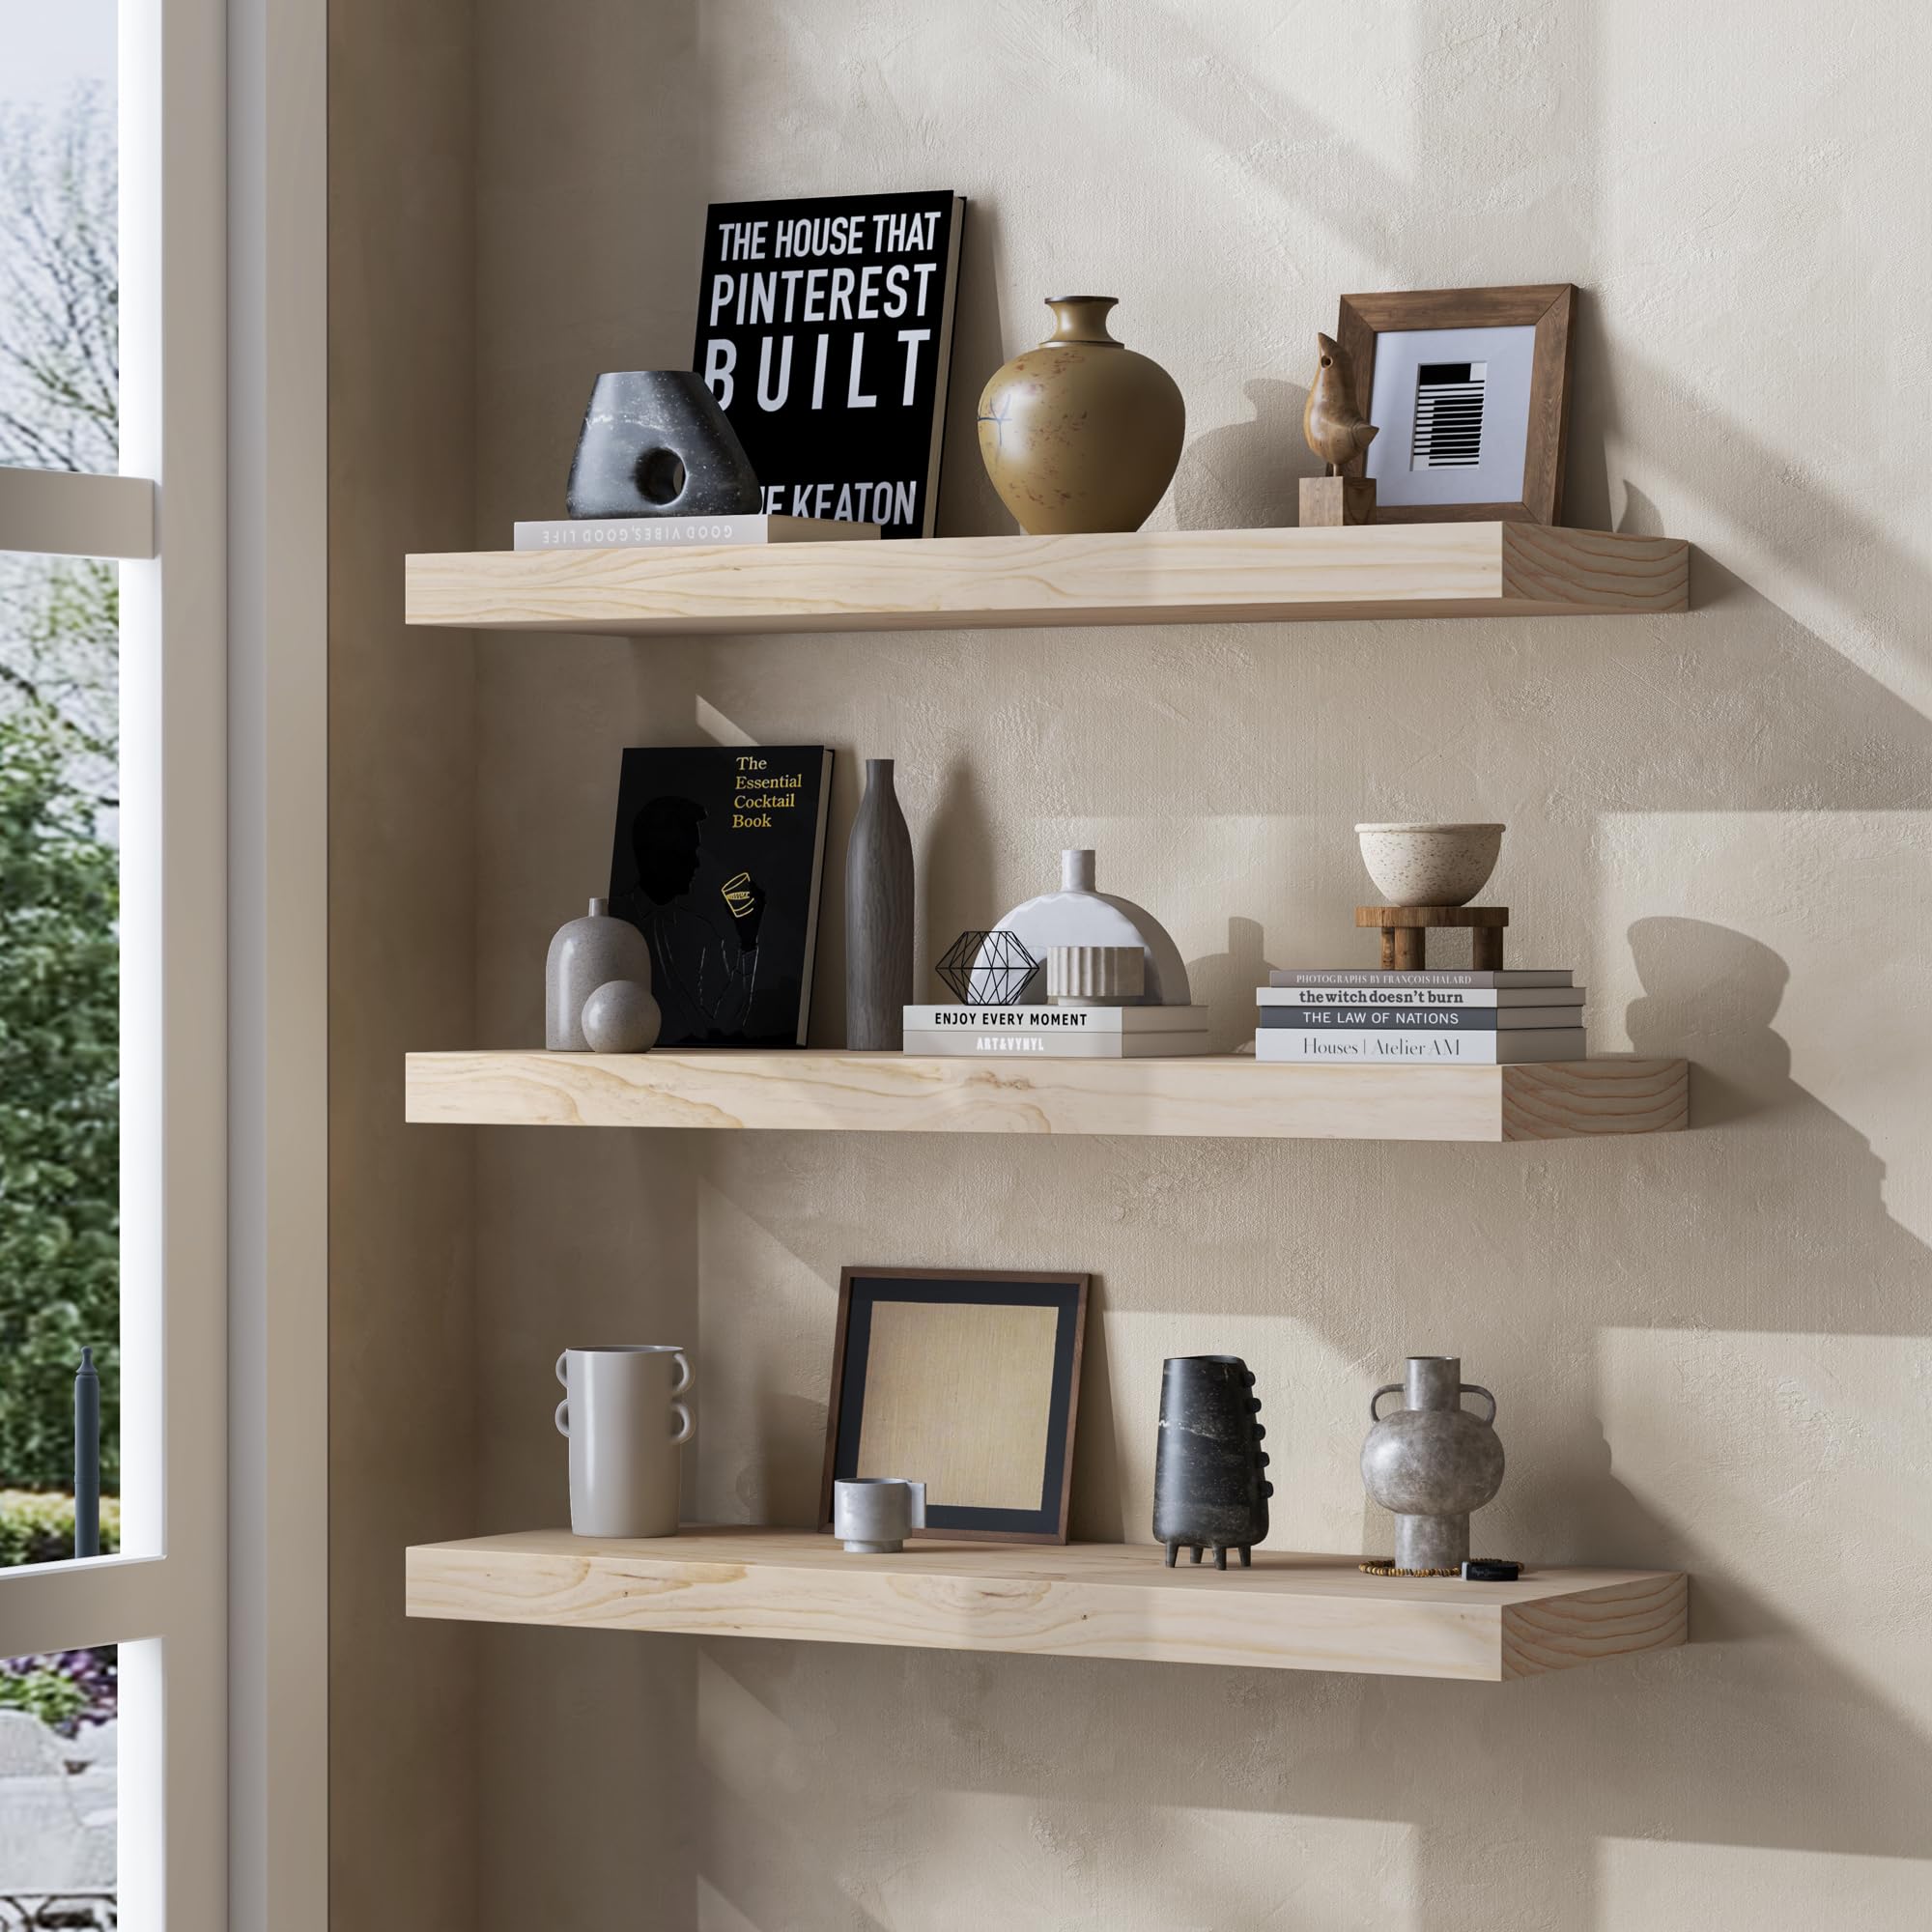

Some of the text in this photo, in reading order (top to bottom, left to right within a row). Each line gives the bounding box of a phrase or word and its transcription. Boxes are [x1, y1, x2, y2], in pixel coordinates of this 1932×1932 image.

[720, 211, 942, 262] THE HOUSE THAT
[709, 263, 937, 327] PINTEREST
[704, 329, 931, 412] BUILT
[541, 529, 576, 544] LIFE
[687, 525, 733, 540] GOOD
[736, 756, 767, 771] The
[735, 774, 802, 789] Essential
[734, 793, 795, 809] Cocktail
[732, 813, 772, 828] Book
[1296, 974, 1472, 985] PHOTOGRAPHS BY FRANÇOIS HALARD
[1428, 990, 1463, 1004] burn
[935, 1012, 1087, 1026] ENJOY EVERY MOMENT
[1303, 1011, 1460, 1024] THE LAW OF NATIONS
[1304, 1037, 1358, 1055] Houses
[1372, 1038, 1426, 1056] Atelier
[1429, 1038, 1460, 1056] AM
